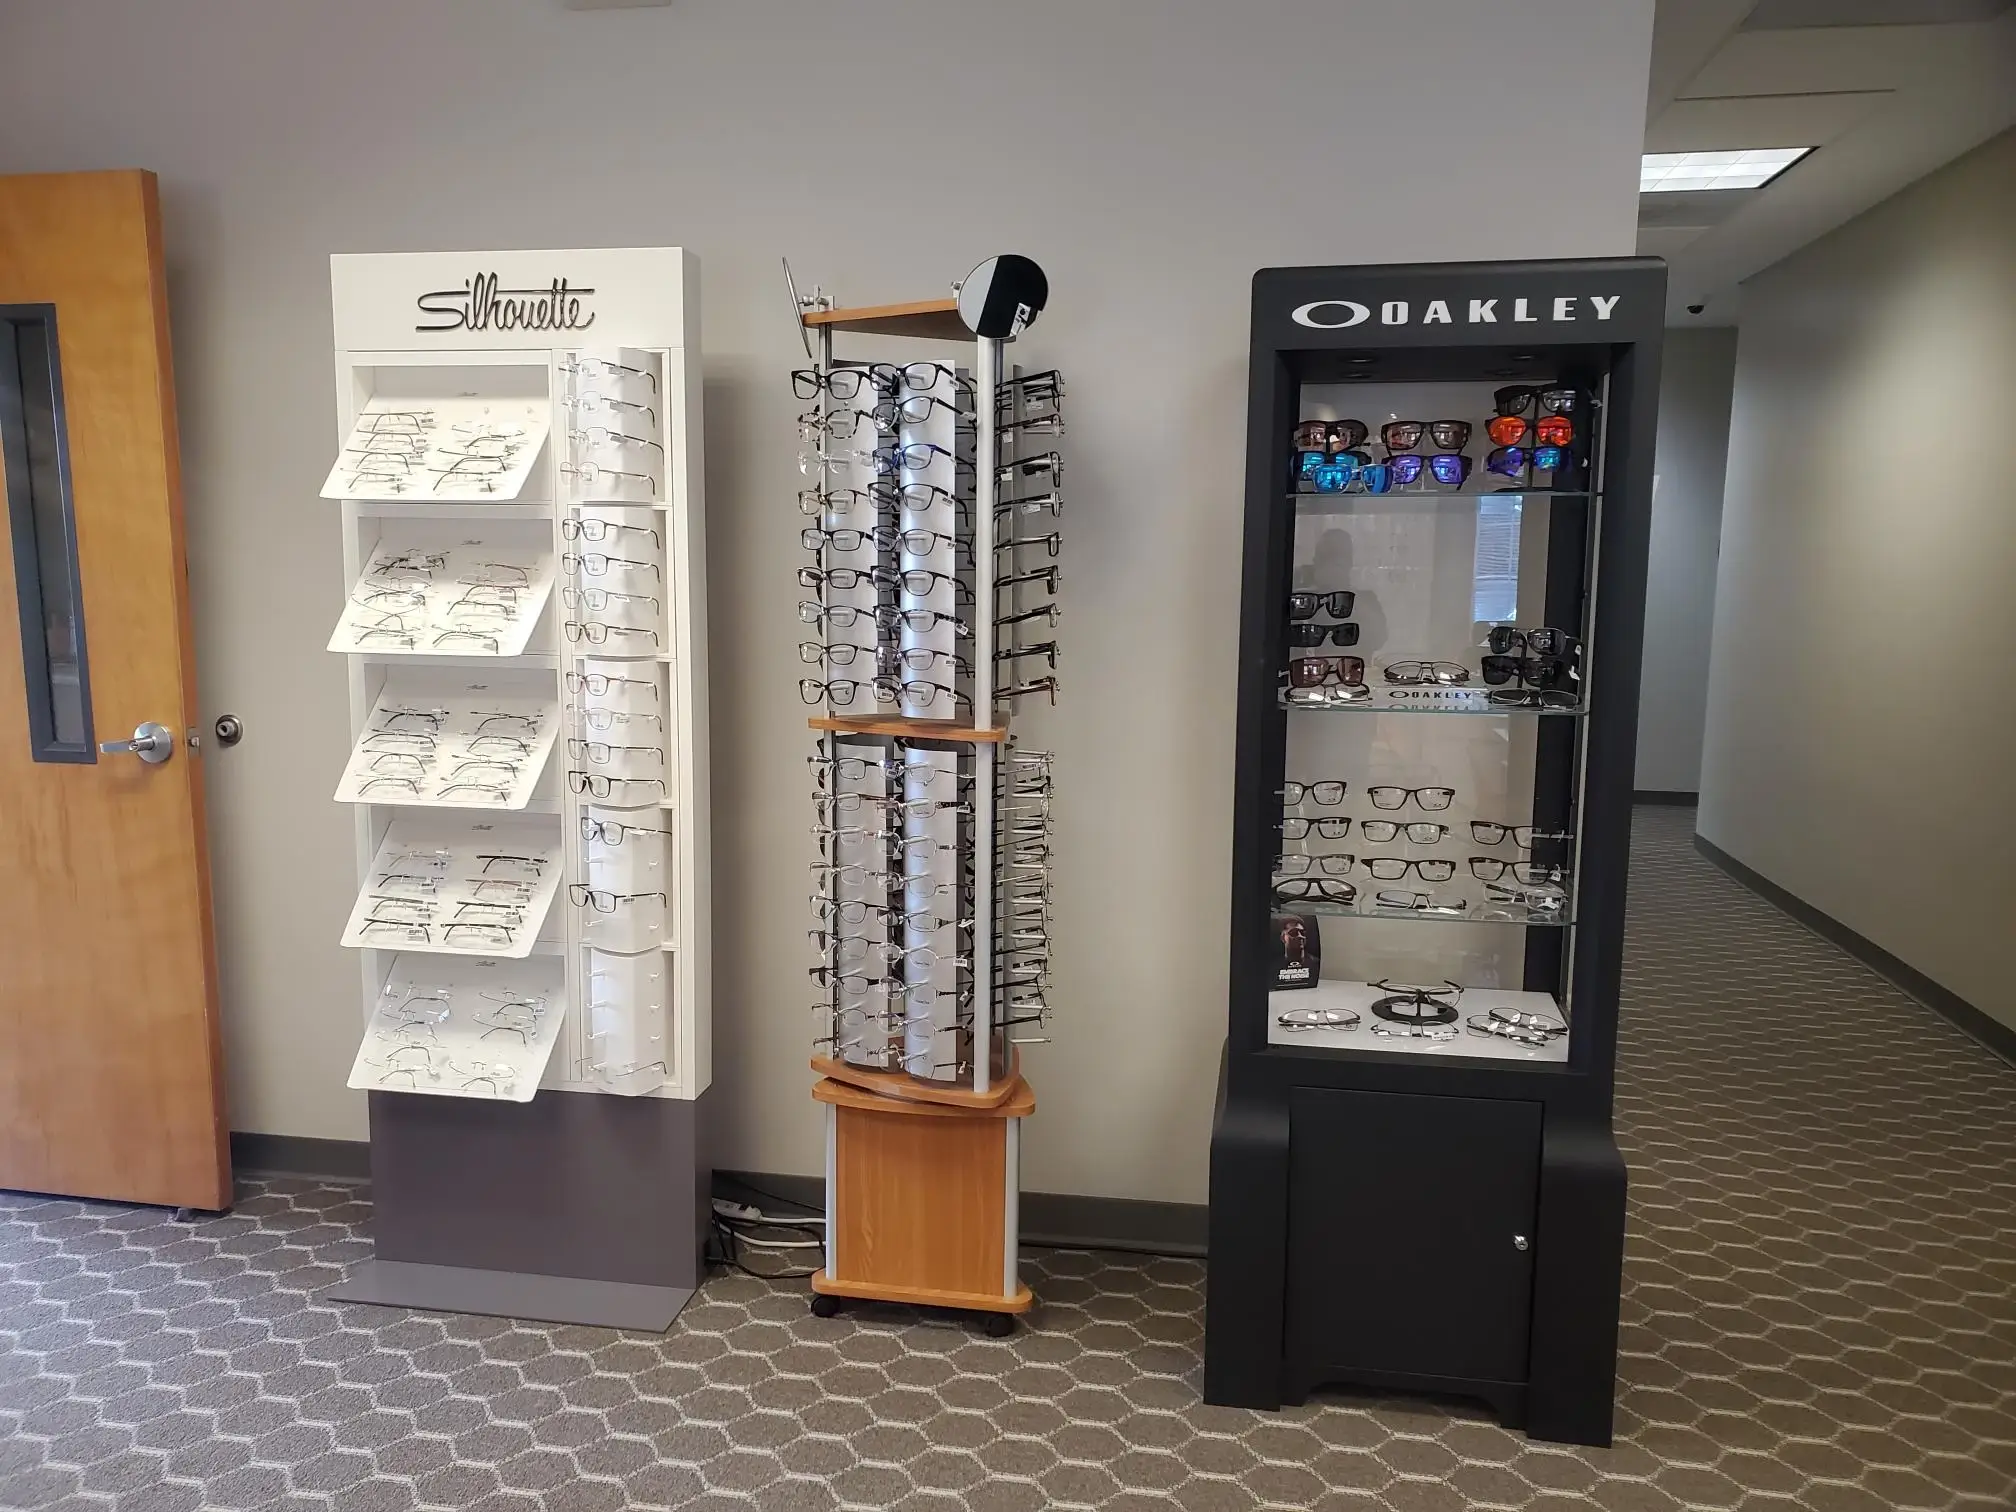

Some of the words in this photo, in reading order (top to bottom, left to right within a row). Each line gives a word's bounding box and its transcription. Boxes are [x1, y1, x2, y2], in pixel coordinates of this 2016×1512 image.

[416, 271, 595, 331] Silhouette
[1381, 295, 1620, 325] OAKLEY
[1411, 691, 1472, 699] OAKLEY
